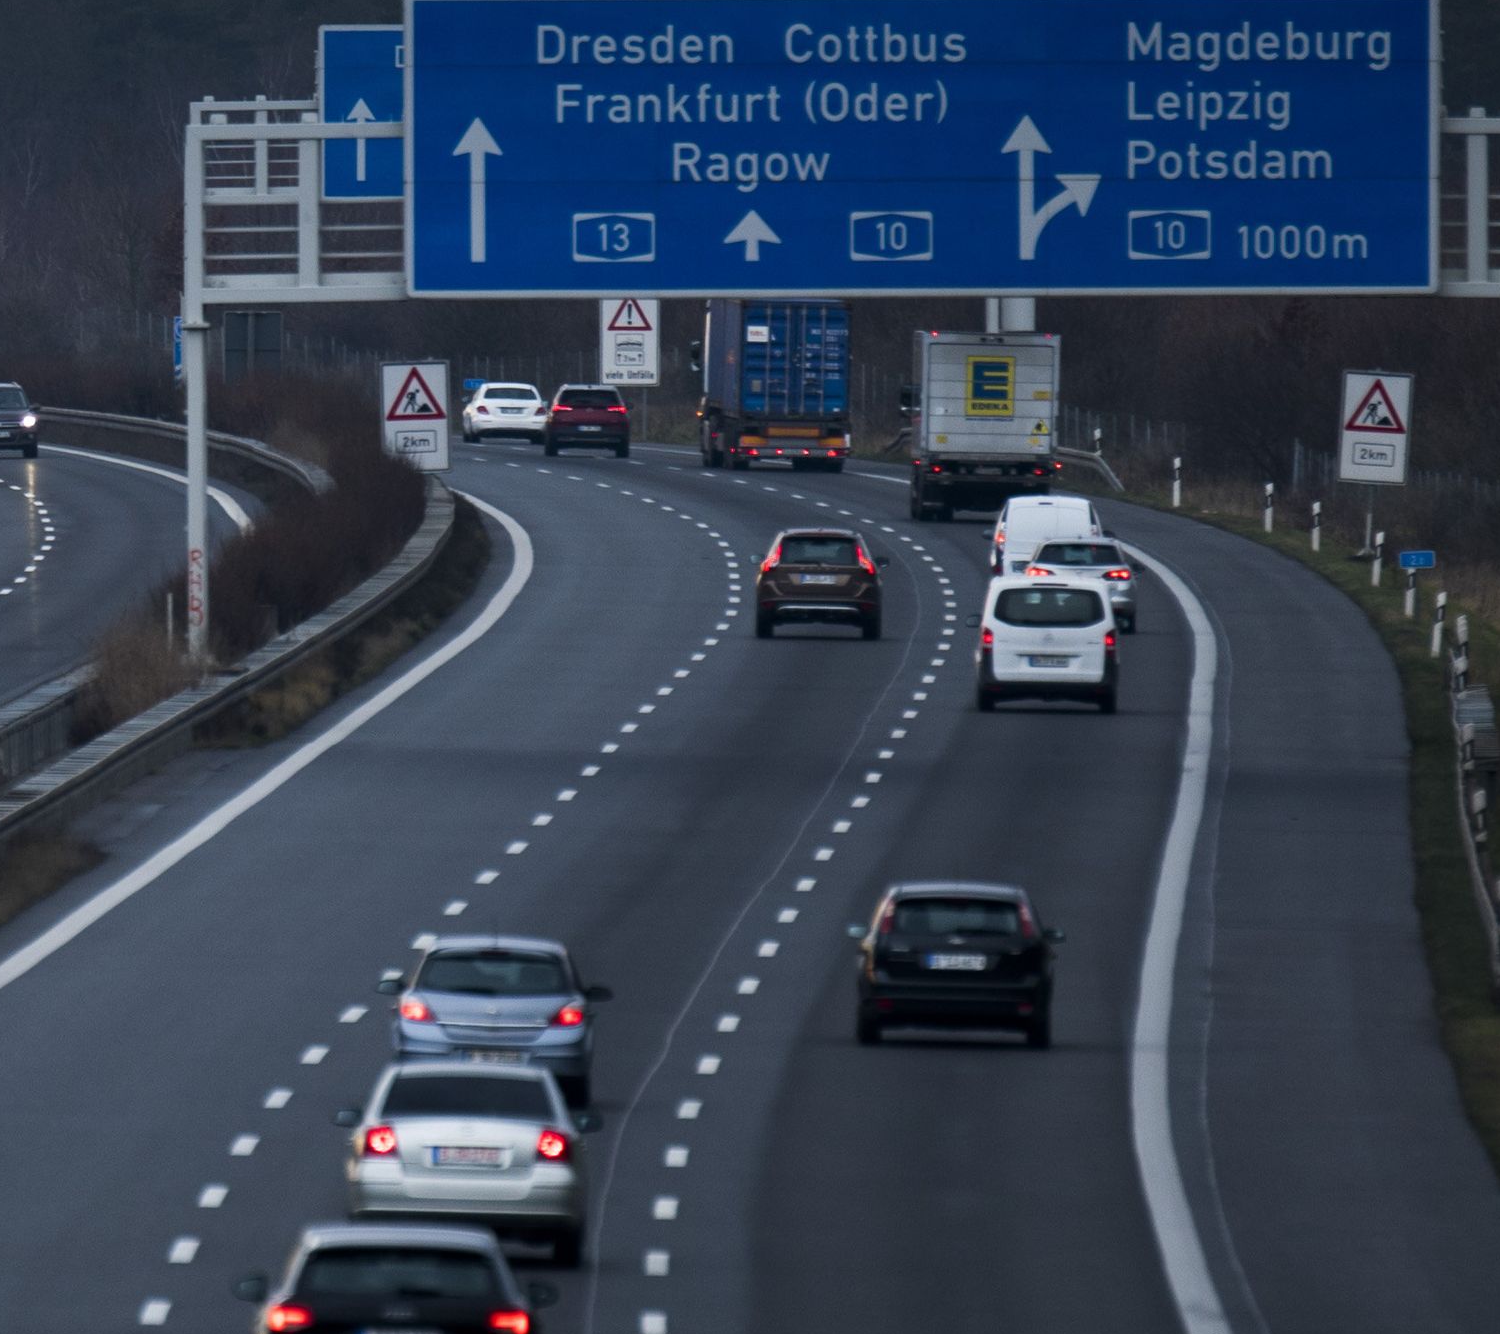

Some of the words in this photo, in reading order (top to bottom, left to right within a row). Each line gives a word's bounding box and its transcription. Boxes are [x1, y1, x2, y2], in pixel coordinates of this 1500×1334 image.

[536, 25, 734, 64] Dresden
[784, 23, 967, 64] Cottbus
[1127, 21, 1391, 72] Magdeburg
[556, 83, 781, 124] Frankfurt
[804, 80, 948, 125] (Oder)
[1127, 80, 1290, 130] Leipzig
[673, 142, 830, 193] Ragow
[1127, 140, 1332, 180] Potsdam
[598, 223, 630, 253] 13
[876, 222, 907, 252] 10
[1154, 220, 1186, 250] 10
[605, 370, 623, 380] viele
[627, 370, 655, 380] Unfälle
[971, 402, 1009, 411] EDEKA
